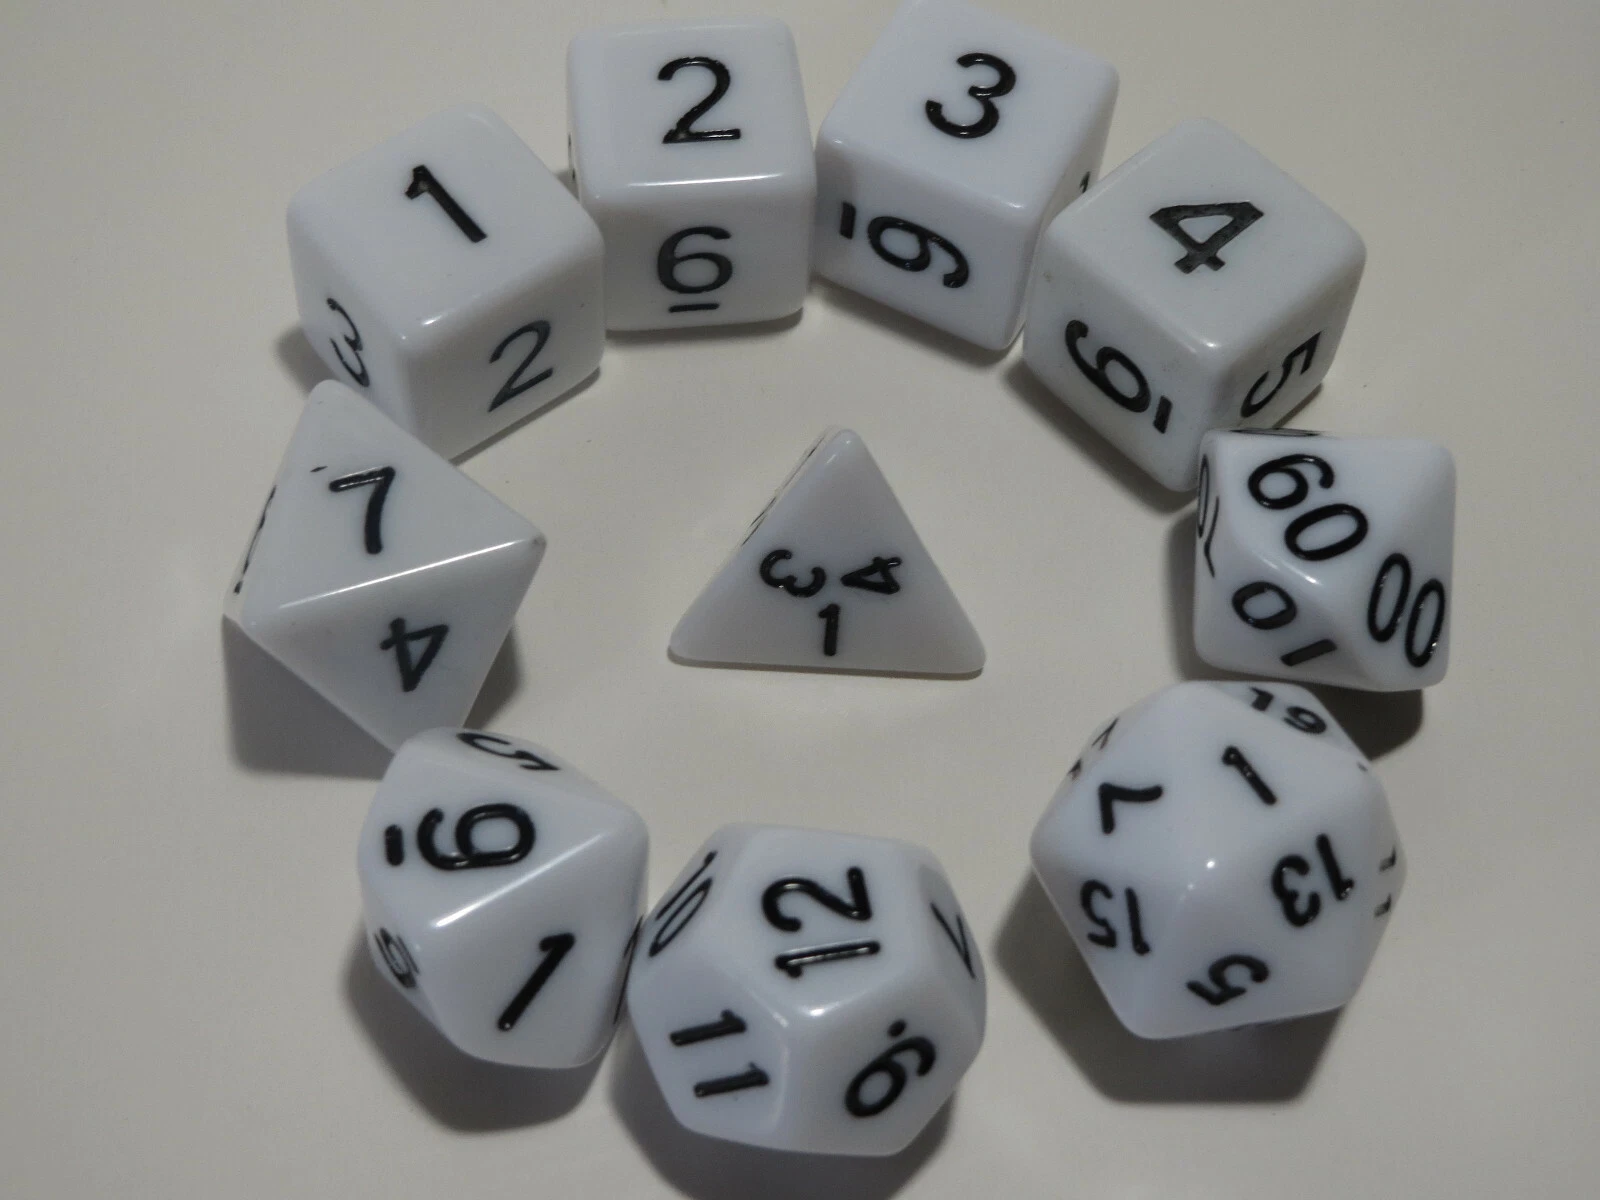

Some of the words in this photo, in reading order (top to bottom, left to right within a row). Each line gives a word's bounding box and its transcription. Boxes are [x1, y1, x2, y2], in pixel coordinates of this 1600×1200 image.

[658, 57, 741, 143] 2
[926, 53, 1016, 138] 3
[405, 165, 488, 243] 1
[839, 201, 969, 289] 6
[1150, 201, 1264, 275] 4
[656, 226, 733, 313] 6
[327, 298, 370, 388] 3
[488, 319, 553, 412] 2
[1065, 320, 1172, 434] 6
[1240, 331, 1322, 419] 5
[329, 466, 395, 555] 7
[1248, 454, 1368, 561] 60
[760, 549, 827, 598] 3
[840, 556, 902, 595] 4
[1368, 553, 1446, 668] 00
[380, 617, 449, 692] 4
[817, 603, 841, 656] 1
[457, 732, 558, 771] 5
[1249, 687, 1328, 735] 19
[1098, 782, 1163, 834] 7
[1221, 746, 1277, 806] 1
[649, 851, 717, 957] 10
[762, 866, 881, 979] 12
[1080, 880, 1150, 956] 15
[1271, 834, 1354, 927] 13
[497, 933, 575, 1031] 1
[1186, 954, 1270, 1006] 5
[669, 1009, 770, 1097] 11
